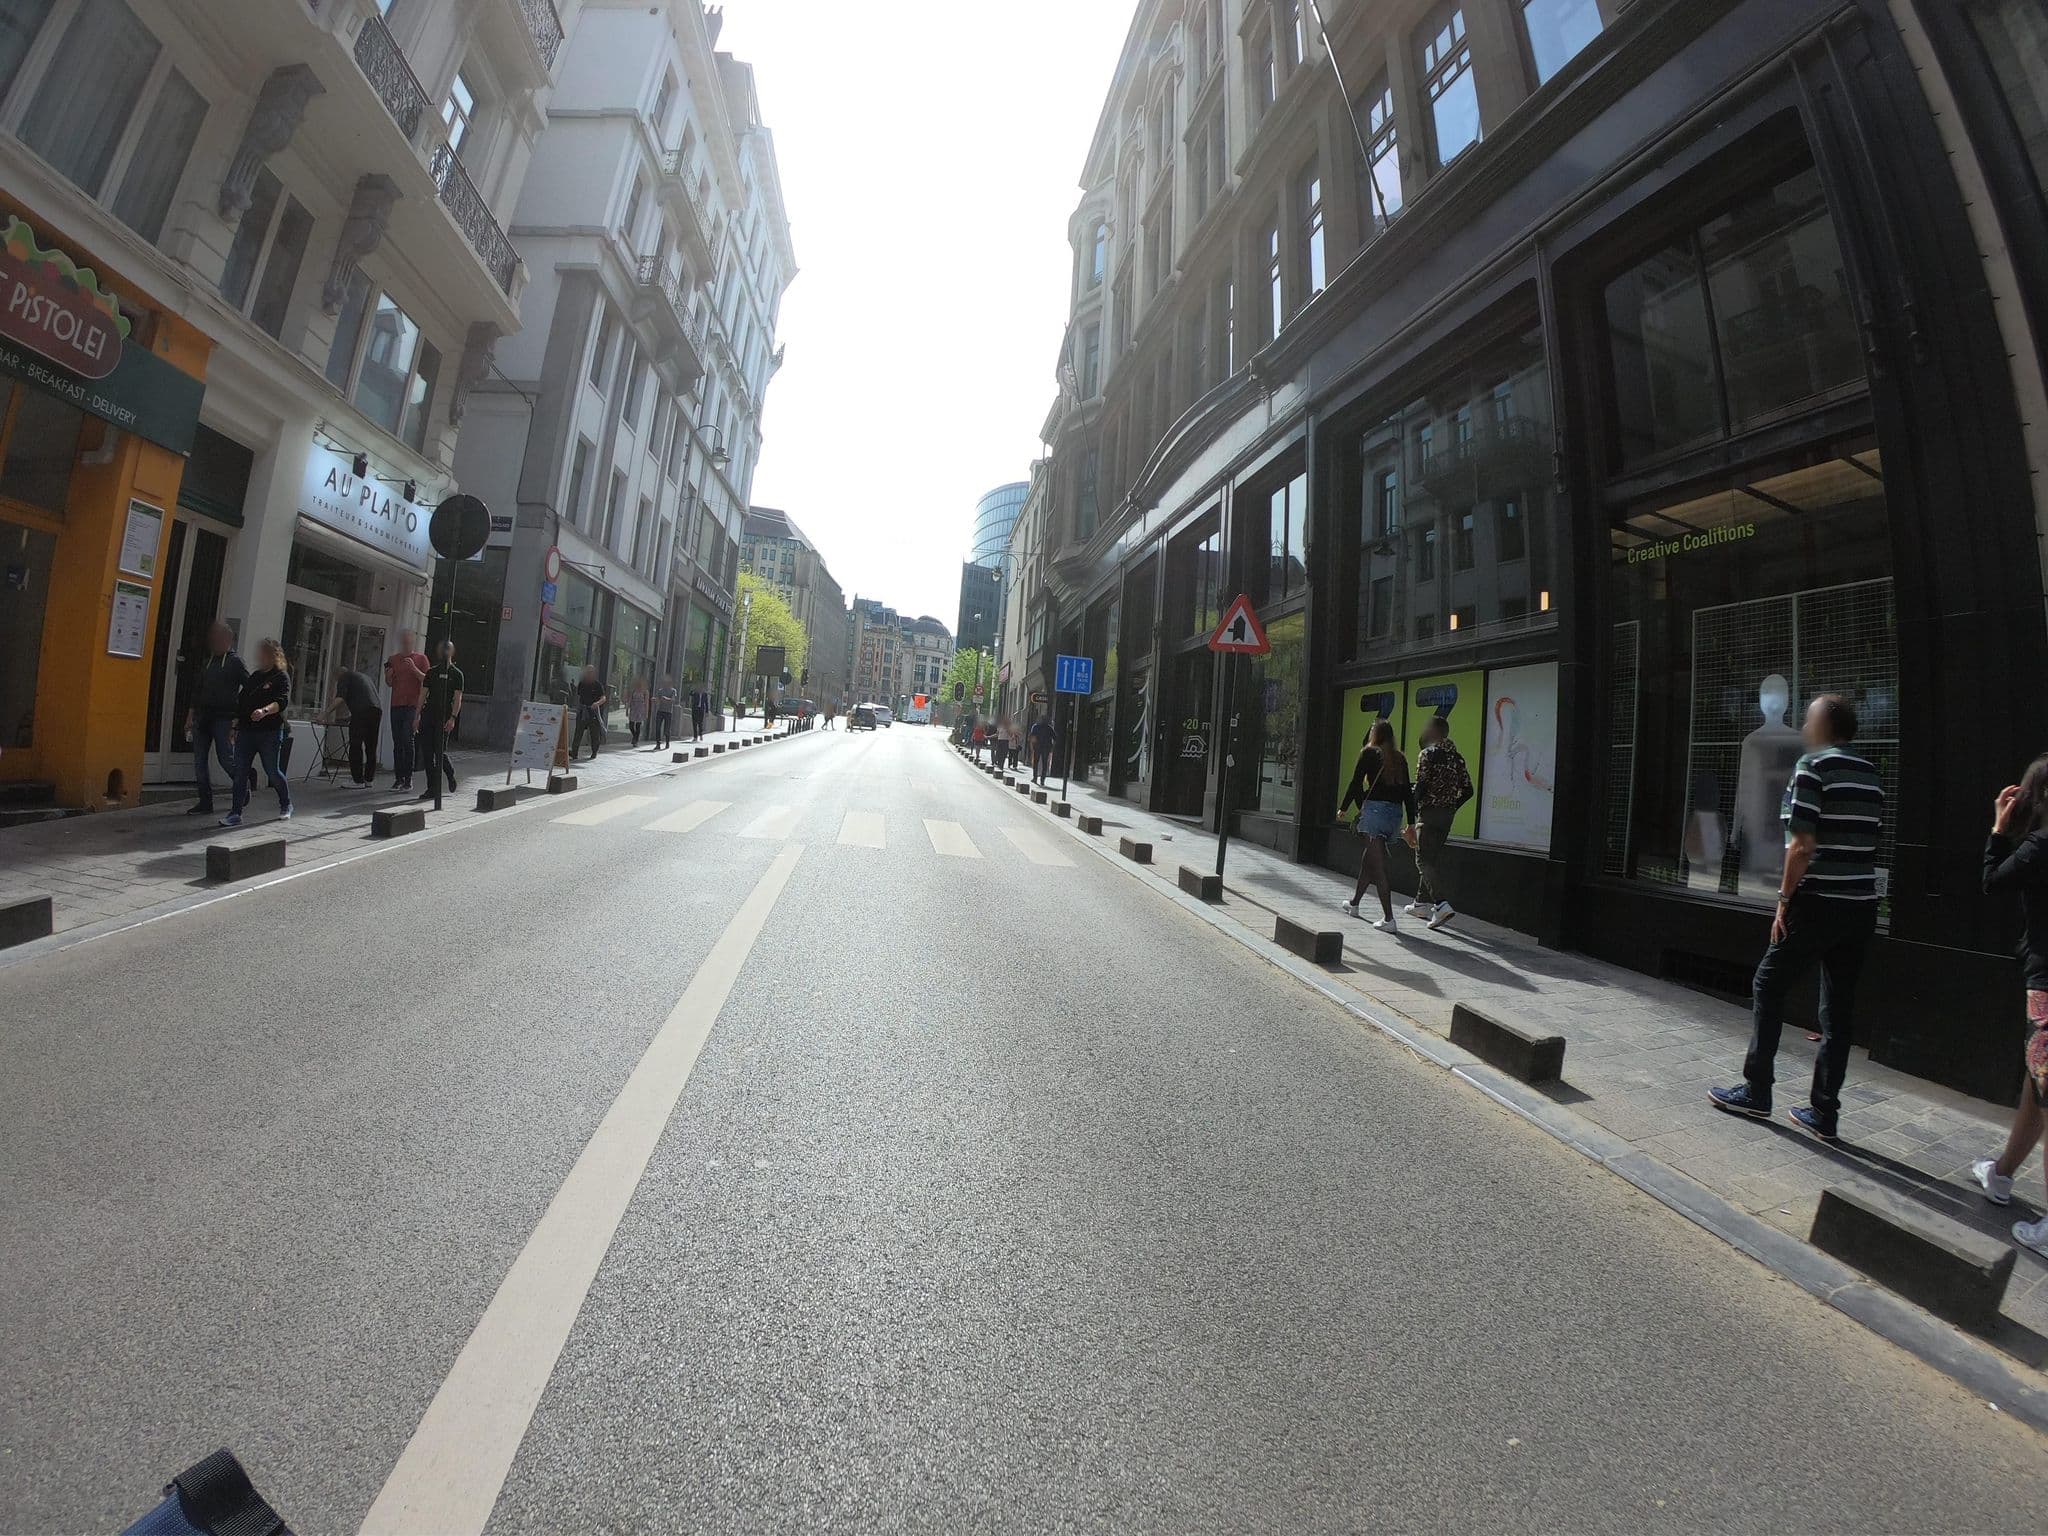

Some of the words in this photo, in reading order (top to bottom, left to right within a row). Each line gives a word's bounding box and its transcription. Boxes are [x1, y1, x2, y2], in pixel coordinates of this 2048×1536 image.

[28, 363, 86, 401] BREAKFAST
[92, 395, 137, 425] DELIVERY
[324, 467, 352, 498] AU
[1627, 541, 1680, 564] Creative
[1683, 523, 1756, 551] Coalitions
